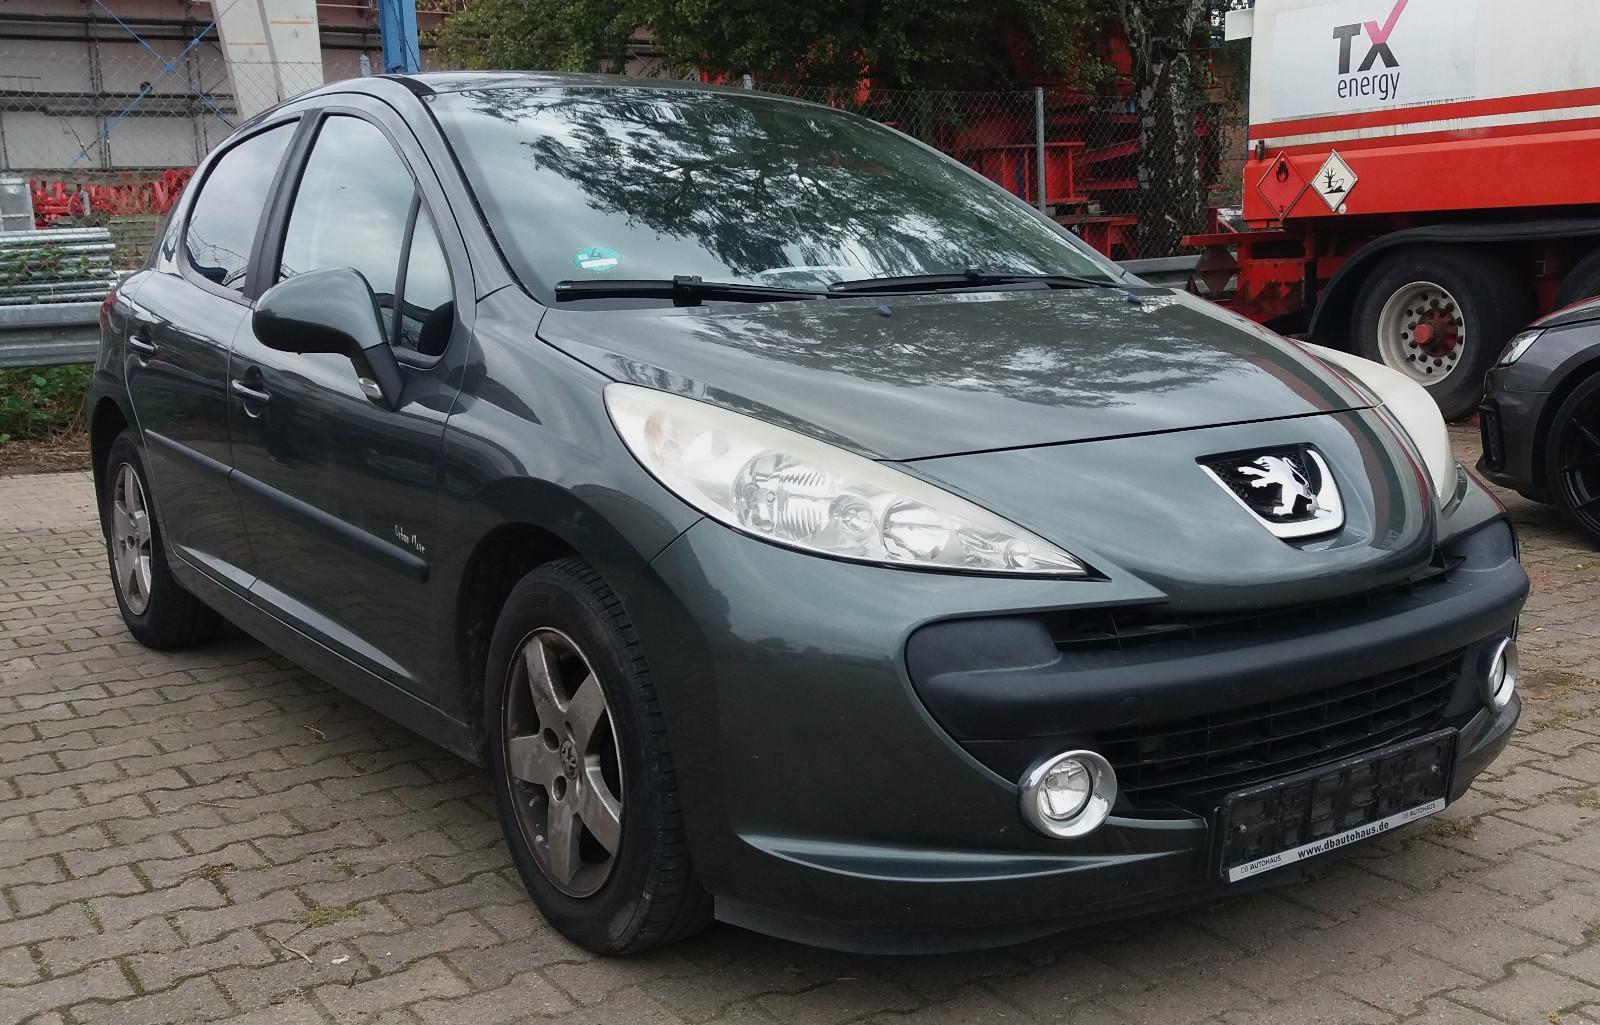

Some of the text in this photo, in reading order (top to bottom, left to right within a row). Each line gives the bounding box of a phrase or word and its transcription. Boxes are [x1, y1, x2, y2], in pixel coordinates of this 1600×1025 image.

[1332, 0, 1406, 75] TX
[1337, 72, 1400, 100] energy
[1297, 820, 1389, 859] www.dbautohaus.de
[1250, 854, 1282, 871] AUTOHAUS
